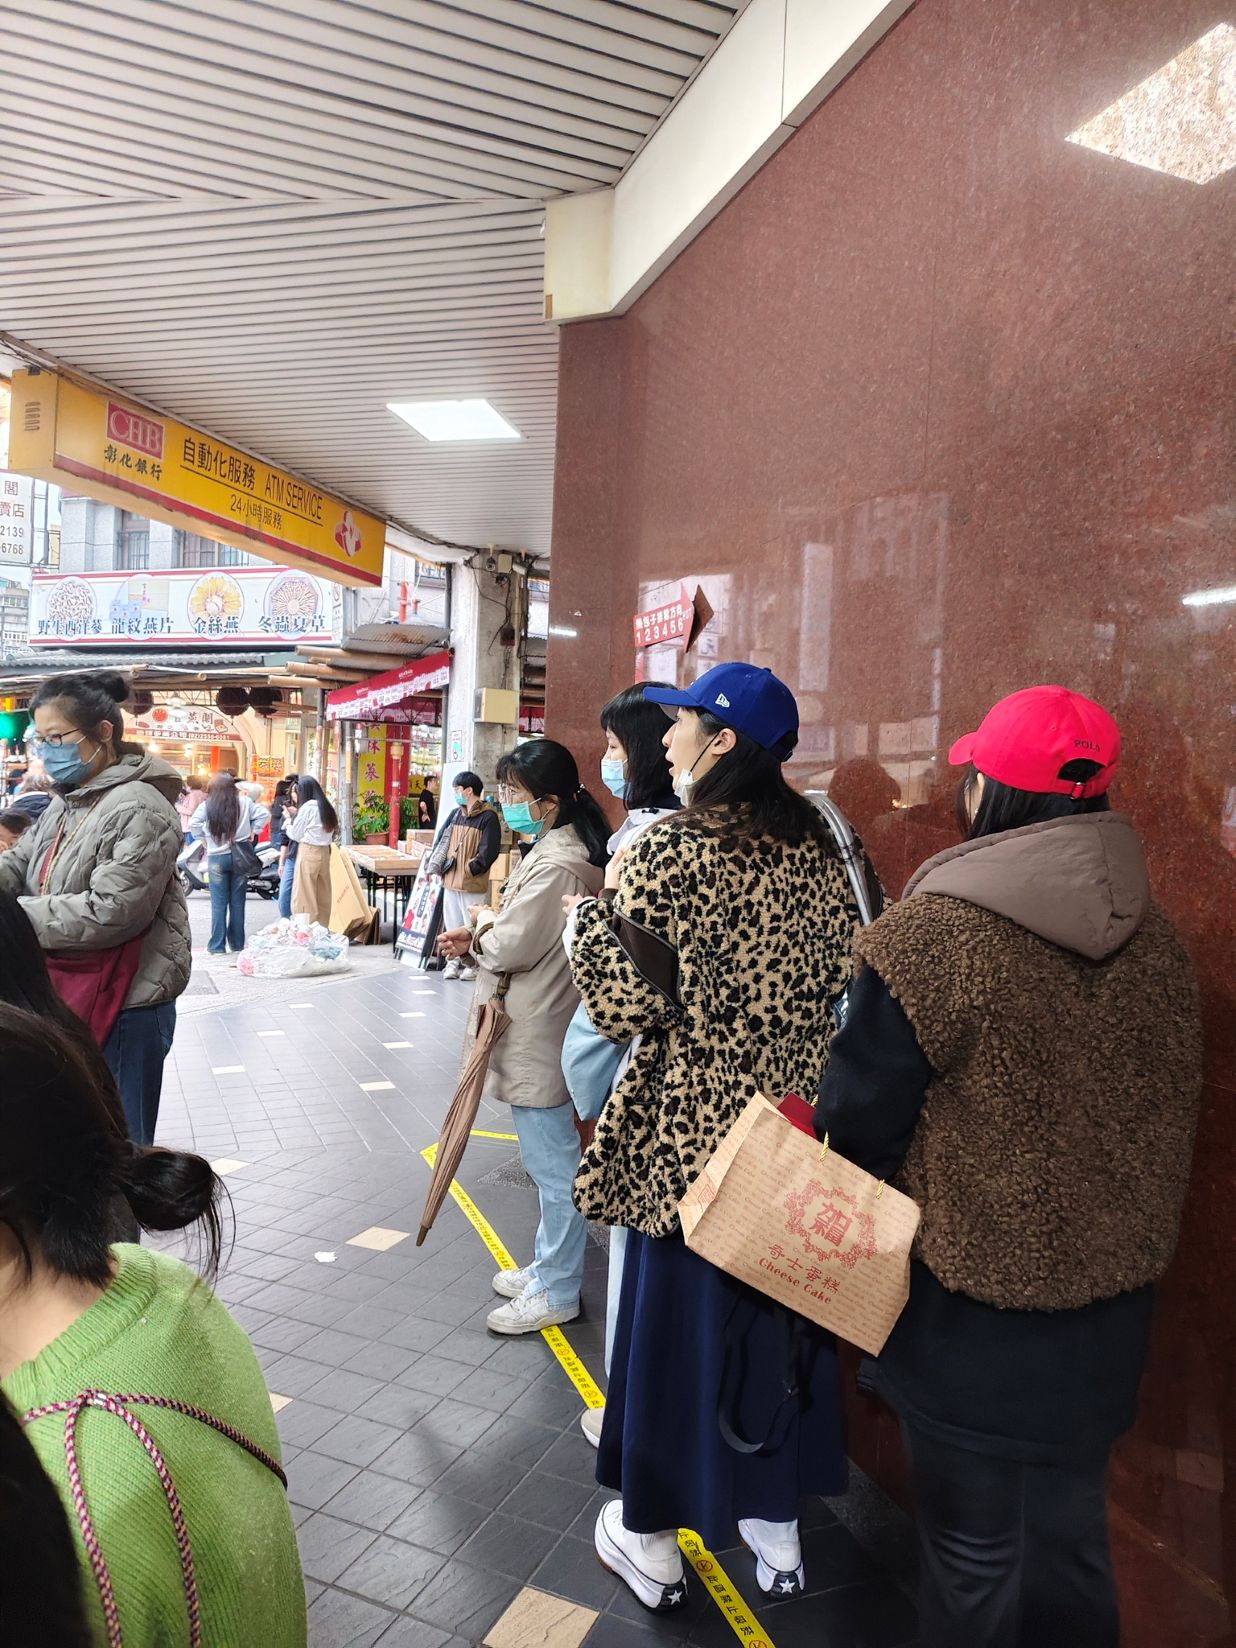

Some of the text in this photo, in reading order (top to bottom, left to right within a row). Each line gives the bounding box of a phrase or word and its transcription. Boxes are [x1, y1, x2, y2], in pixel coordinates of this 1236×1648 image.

[110, 410, 160, 451] CHB
[104, 444, 162, 481] 彰化銀行
[183, 437, 322, 520] 自動化服務 ATM SERVICE
[230, 494, 282, 531] 24小時服務
[0, 525, 24, 538] 2139
[111, 617, 174, 634] 龍紋燕片
[194, 616, 239, 634] 金絲燕
[258, 615, 326, 633] 冬蟲夏草
[1074, 739, 1101, 752] POLO
[759, 1258, 831, 1304] Cheese Cake
[768, 1244, 840, 1294] 奇士蛋糕
[707, 1575, 755, 1636] 此區禁止吸菸
